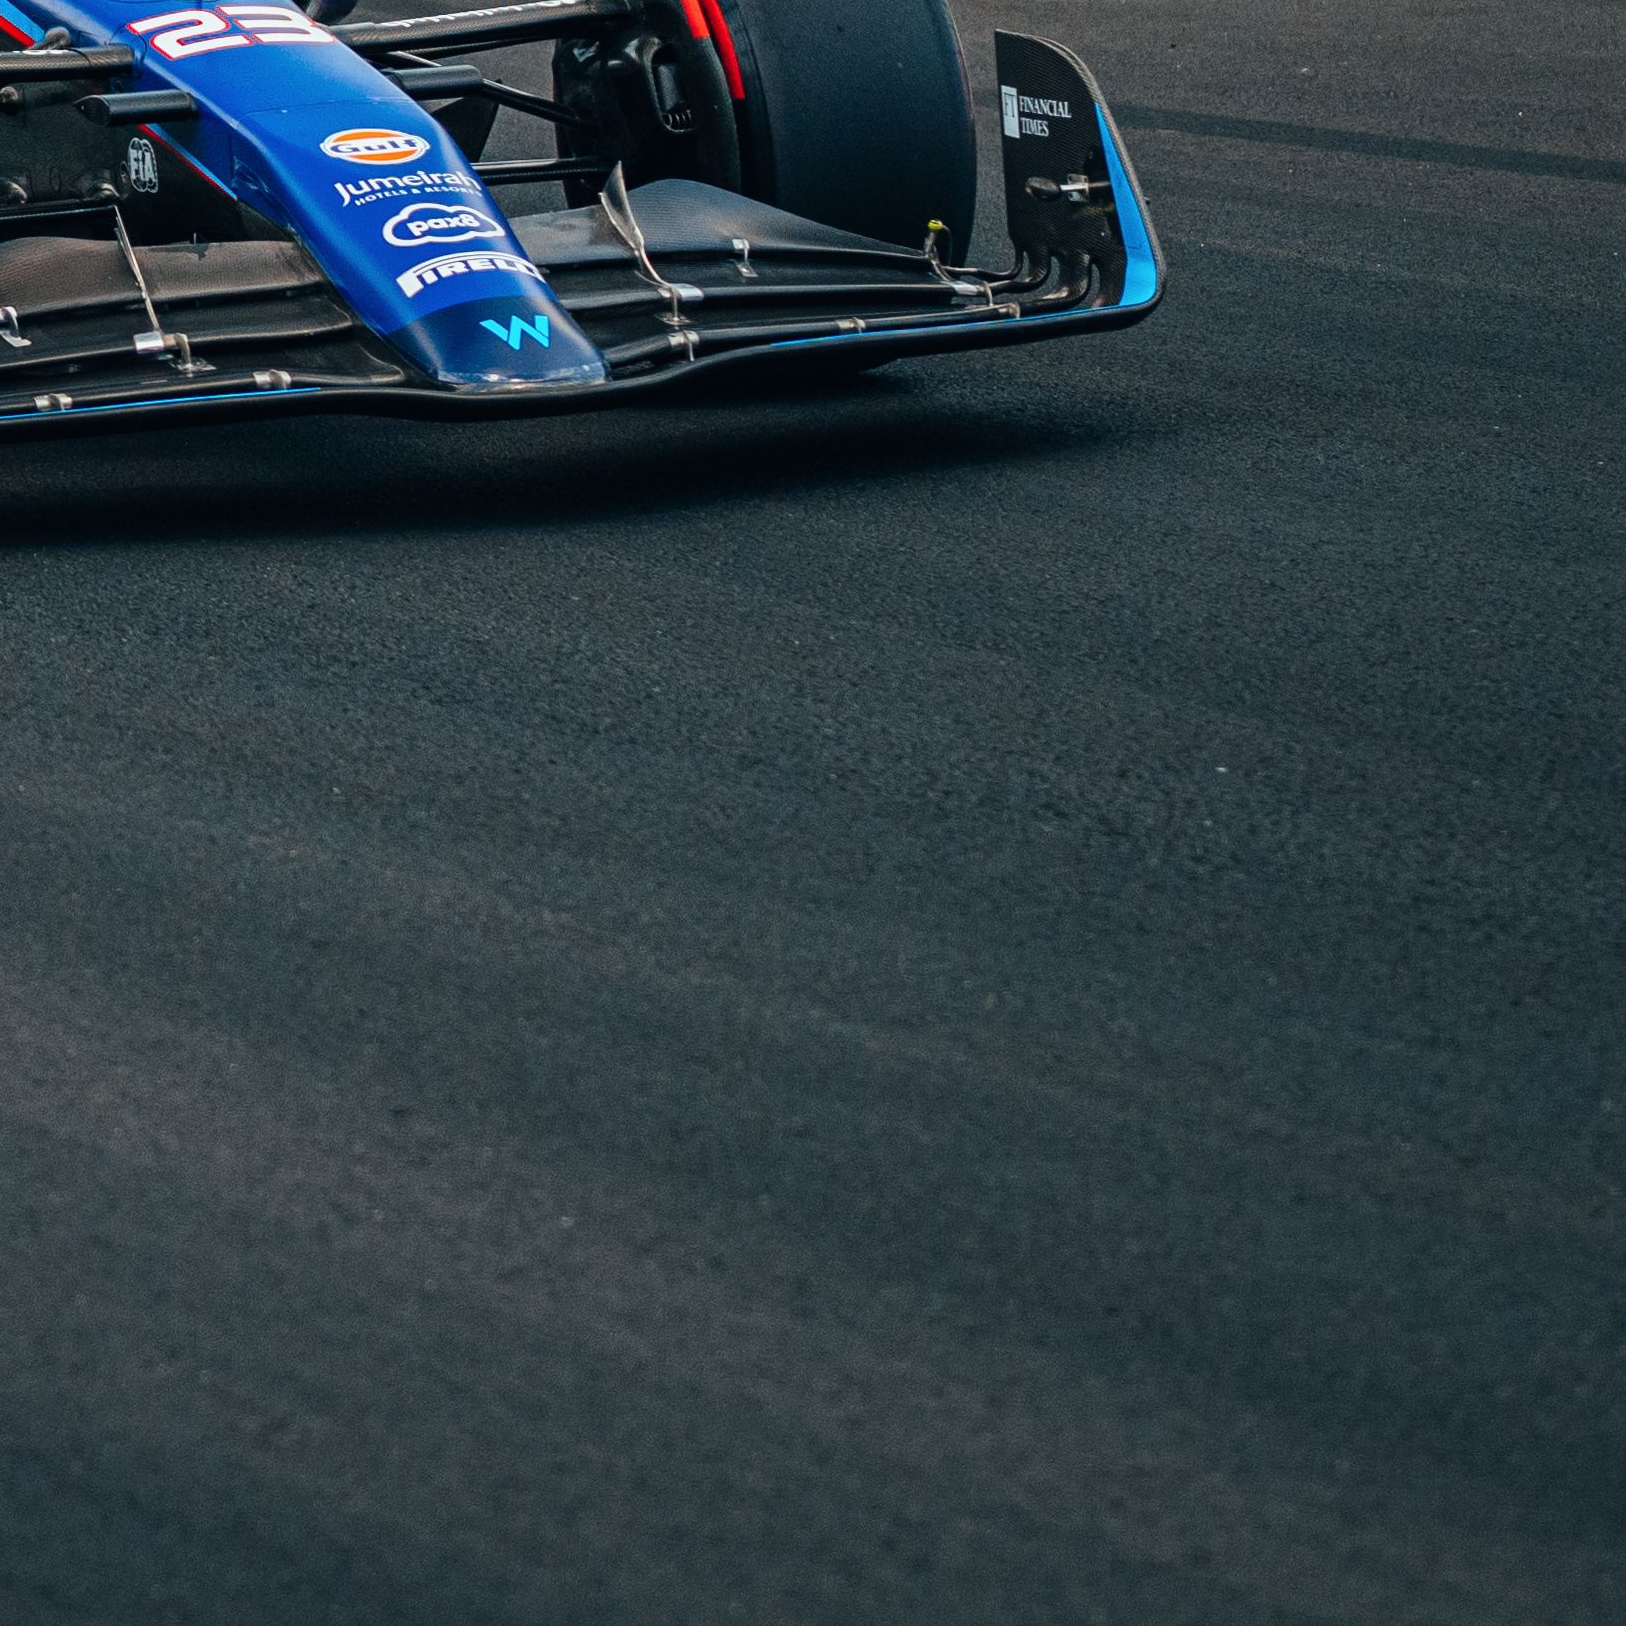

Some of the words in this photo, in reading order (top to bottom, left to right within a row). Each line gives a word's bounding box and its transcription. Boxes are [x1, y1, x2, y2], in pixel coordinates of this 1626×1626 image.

[126, 4, 337, 60] 23
[1019, 96, 1071, 118] FINANCIAL
[1020, 117, 1049, 137] TIMES
[329, 138, 418, 154] Gulf
[333, 170, 482, 208] Jumeirah
[354, 188, 408, 207] HOTELS
[406, 213, 481, 237] pax8
